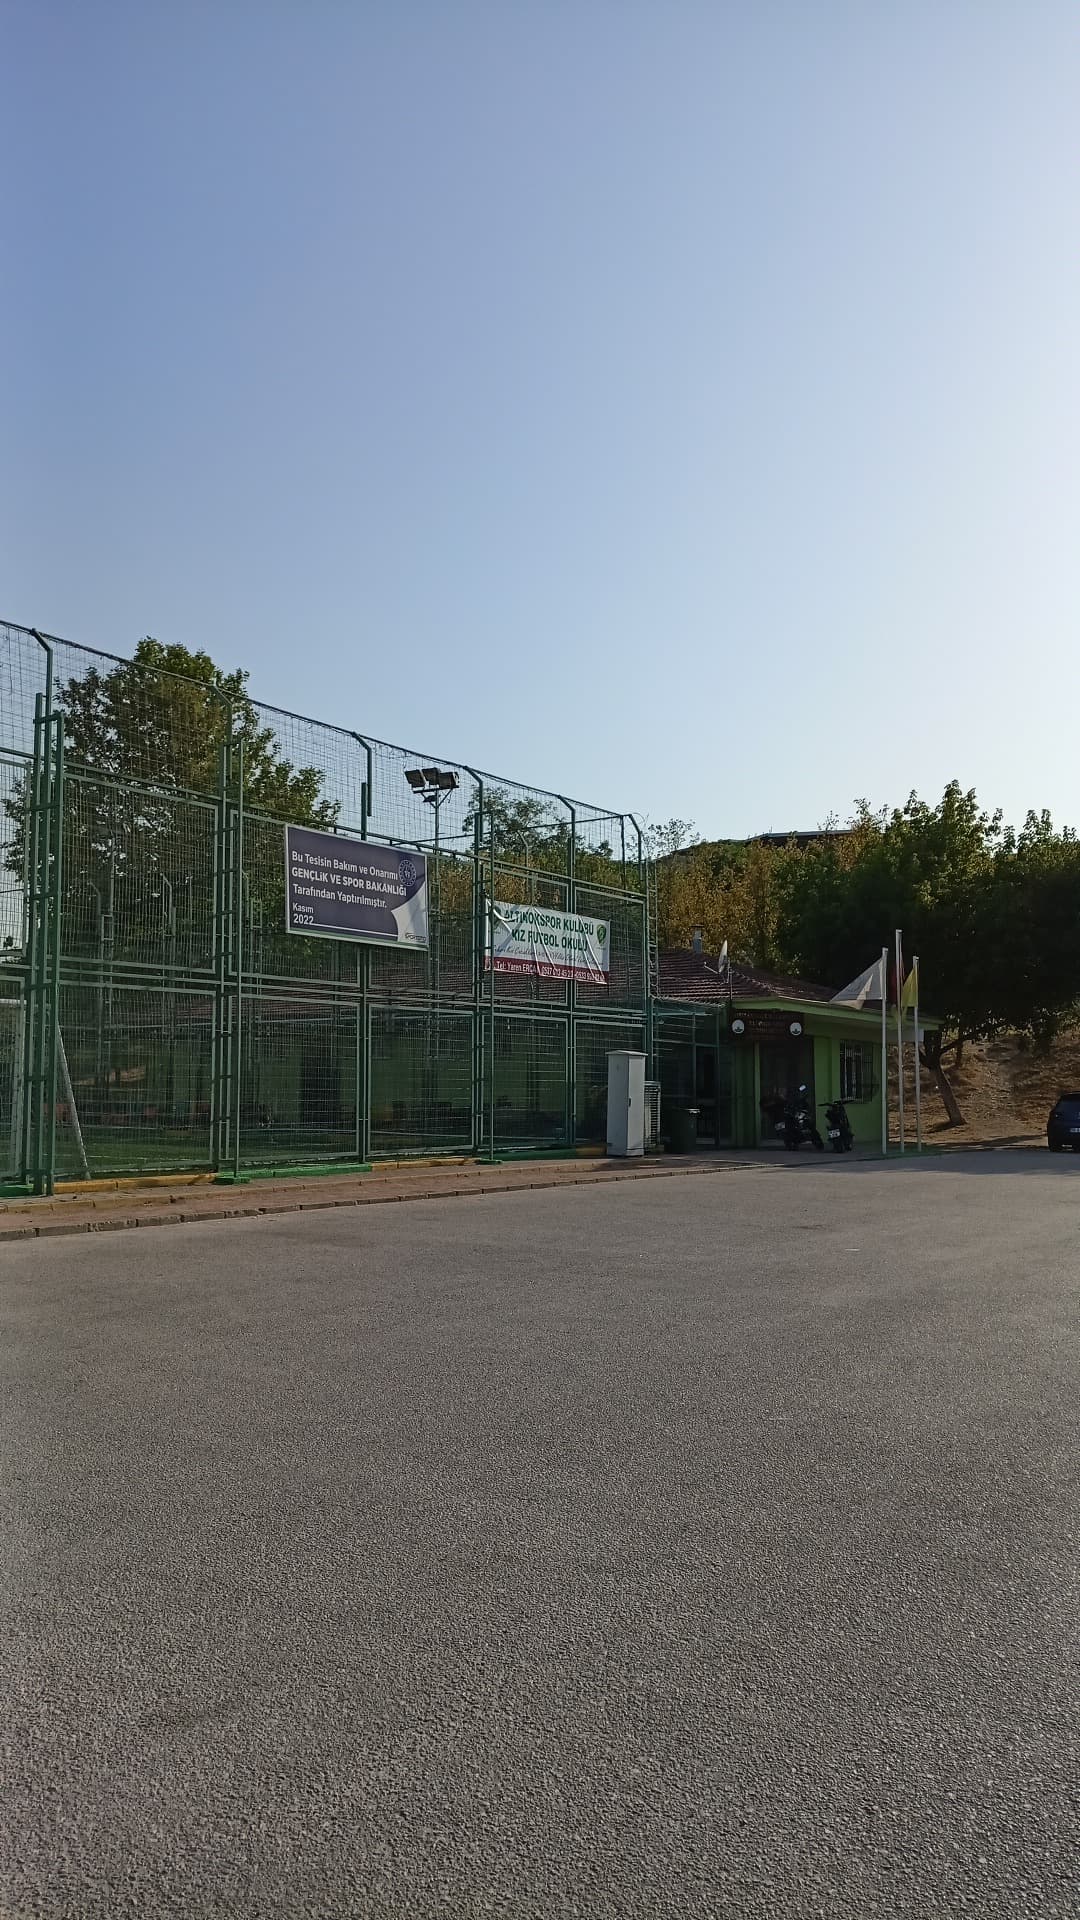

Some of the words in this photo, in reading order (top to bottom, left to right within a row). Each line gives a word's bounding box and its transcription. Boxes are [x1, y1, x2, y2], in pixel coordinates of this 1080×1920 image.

[292, 850, 303, 862] Bu
[305, 853, 332, 868] Tesisin
[333, 859, 358, 873] Bakım
[359, 865, 368, 874] ve
[369, 866, 398, 880] Onarımı
[330, 874, 341, 885] VE
[342, 876, 365, 889] SPOR
[366, 880, 407, 896] BAKANLIĞI
[292, 883, 336, 900] Tarafından
[337, 891, 388, 908] Yaptırılmıştır.
[292, 902, 314, 914] Kasım
[293, 913, 314, 925] 2022
[512, 929, 525, 942] KIZ
